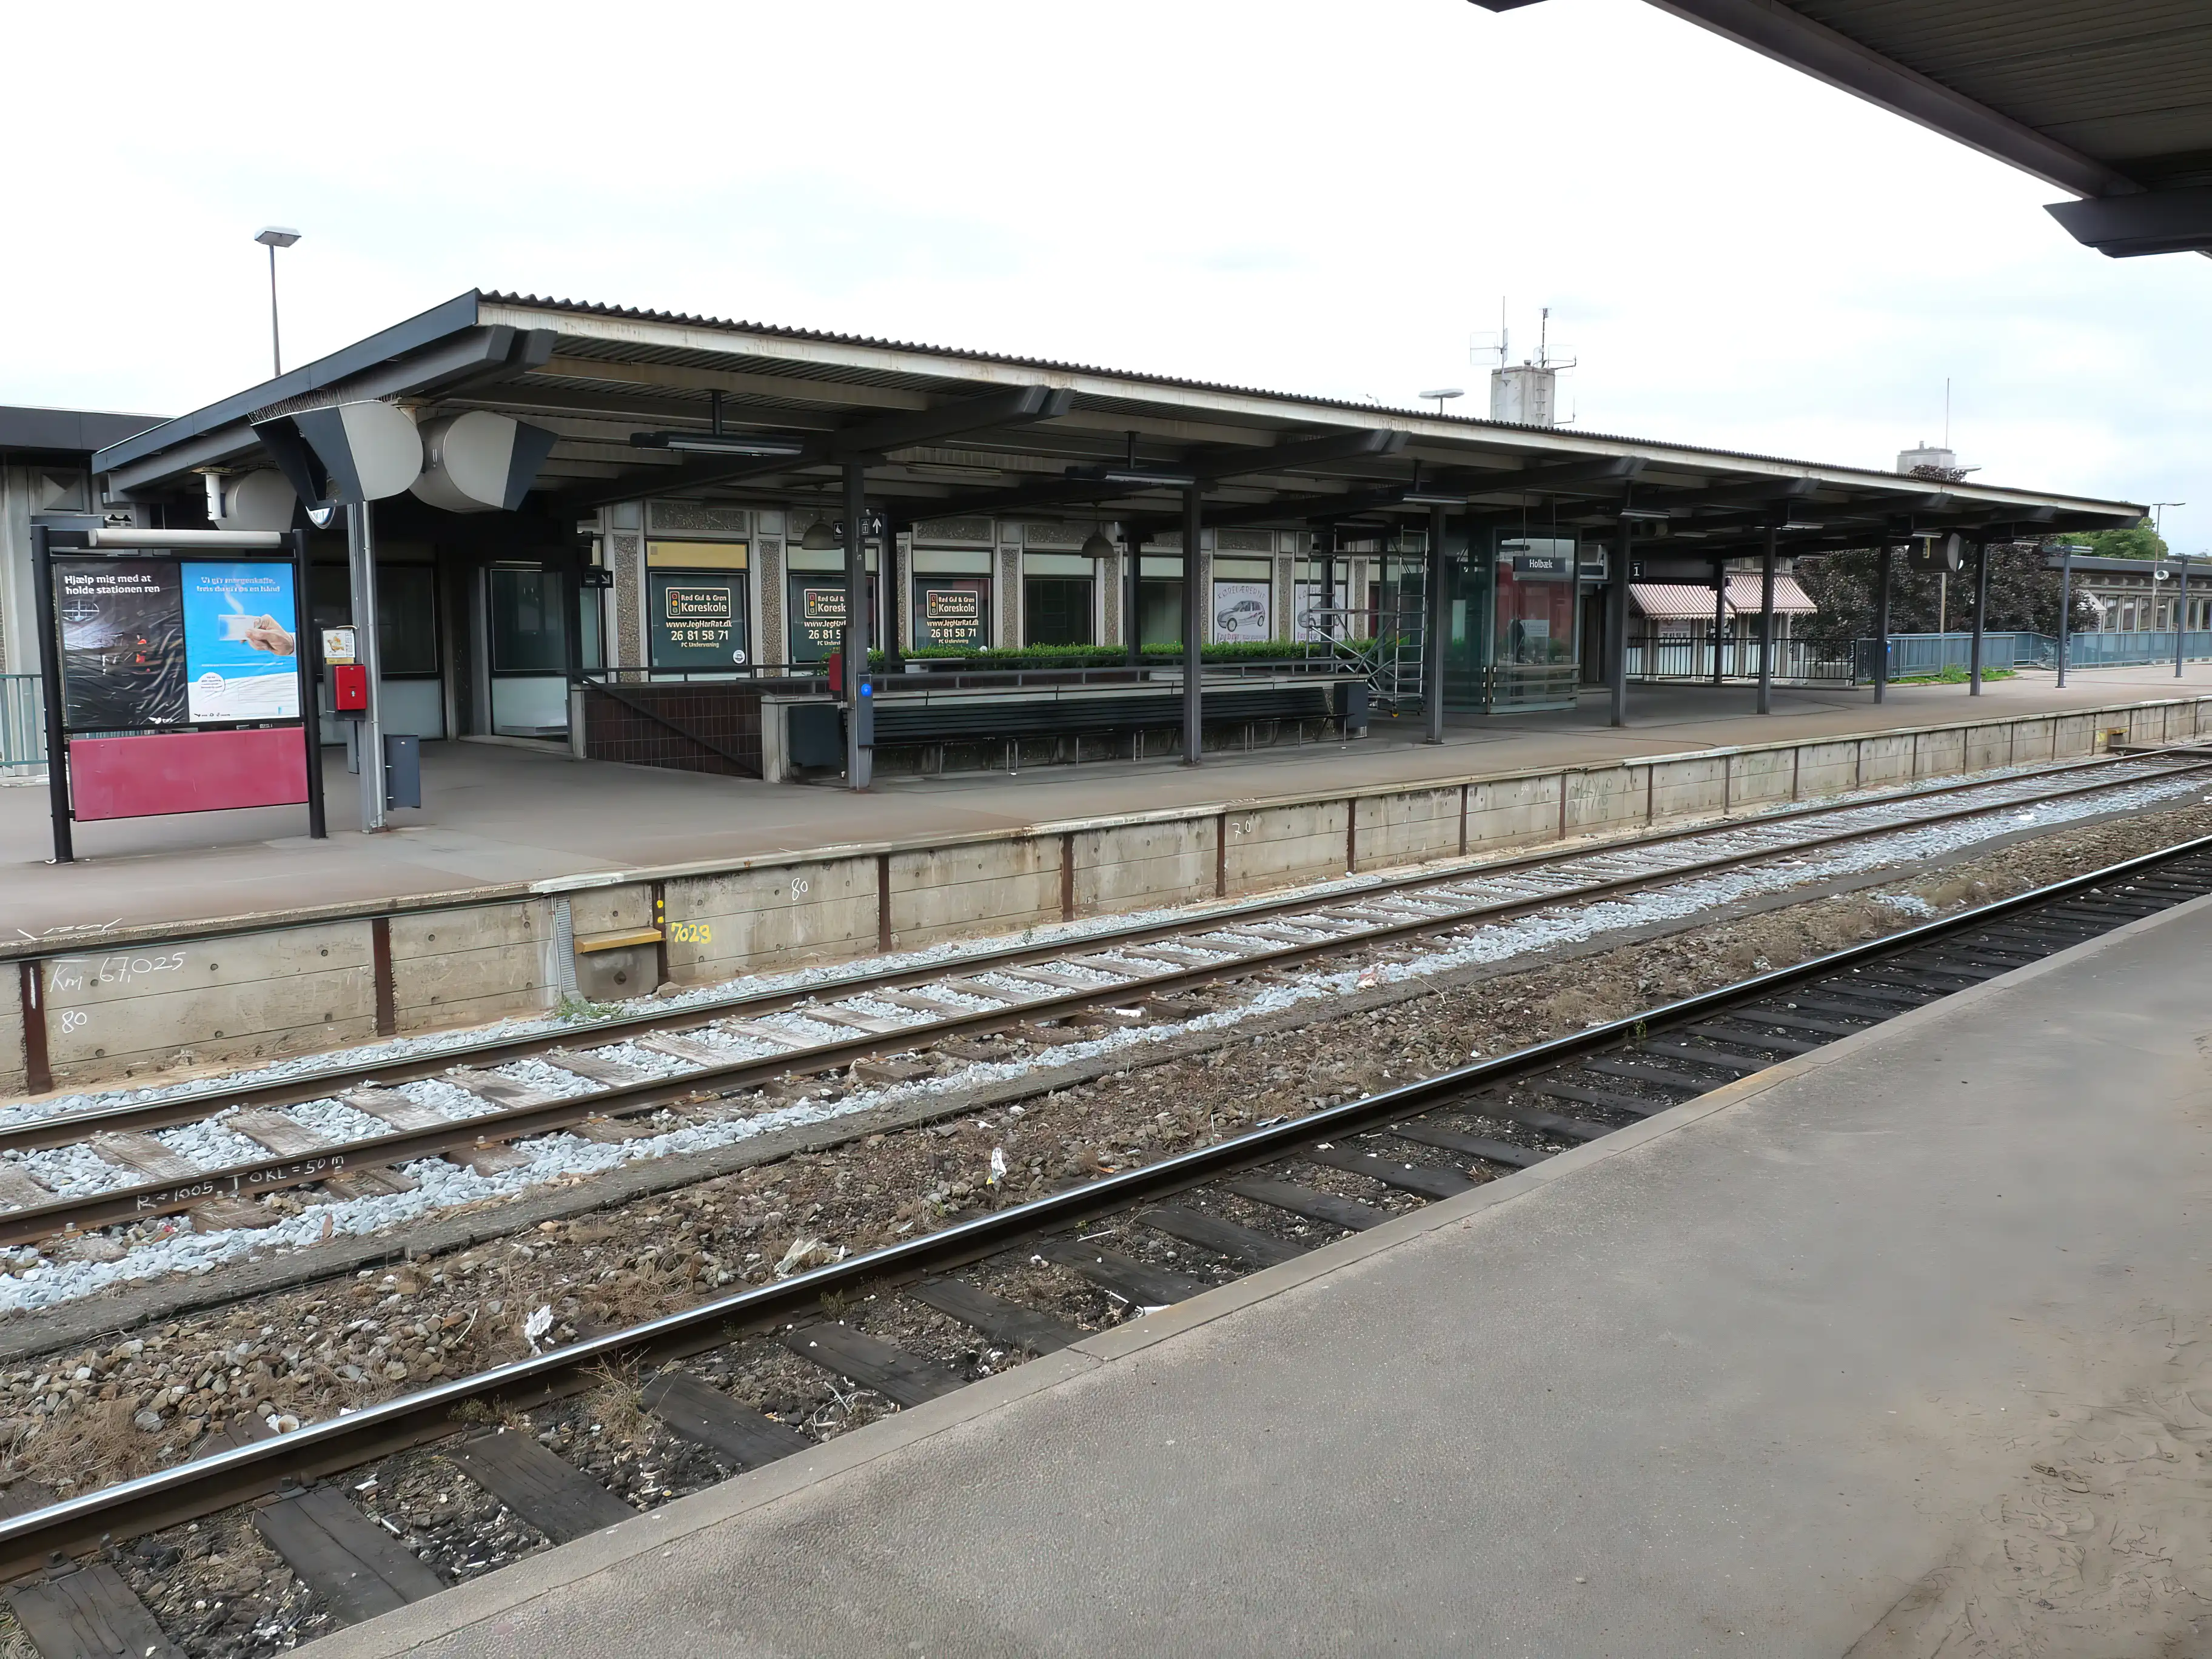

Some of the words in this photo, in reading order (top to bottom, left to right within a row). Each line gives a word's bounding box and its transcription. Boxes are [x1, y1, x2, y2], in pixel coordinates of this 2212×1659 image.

[1529, 558, 1553, 569] Holbæk
[1634, 566, 1640, 576] 1
[64, 575, 94, 585] Hjælp
[96, 575, 116, 584] mig
[118, 574, 139, 583] med
[65, 586, 94, 595] holde
[96, 585, 142, 594] stationen
[681, 602, 727, 612] Køreskole
[817, 603, 846, 612] Køresk
[939, 603, 974, 612] Køreskole
[666, 620, 732, 629] www.JegHarRat.dk
[671, 631, 683, 640] 26
[687, 631, 698, 640] 81
[702, 630, 714, 640] 58
[718, 630, 728, 640] 71
[808, 630, 819, 639] 26
[823, 630, 833, 639] 81
[836, 630, 840, 639] 5
[931, 629, 940, 637] 26
[943, 629, 953, 637] 81
[955, 628, 965, 637] 58
[968, 628, 976, 637] 71
[1232, 820, 1251, 840] 70
[792, 878, 808, 900] 80
[49, 964, 83, 993] Km
[100, 952, 186, 983] 67,025
[62, 1010, 87, 1034] 80
